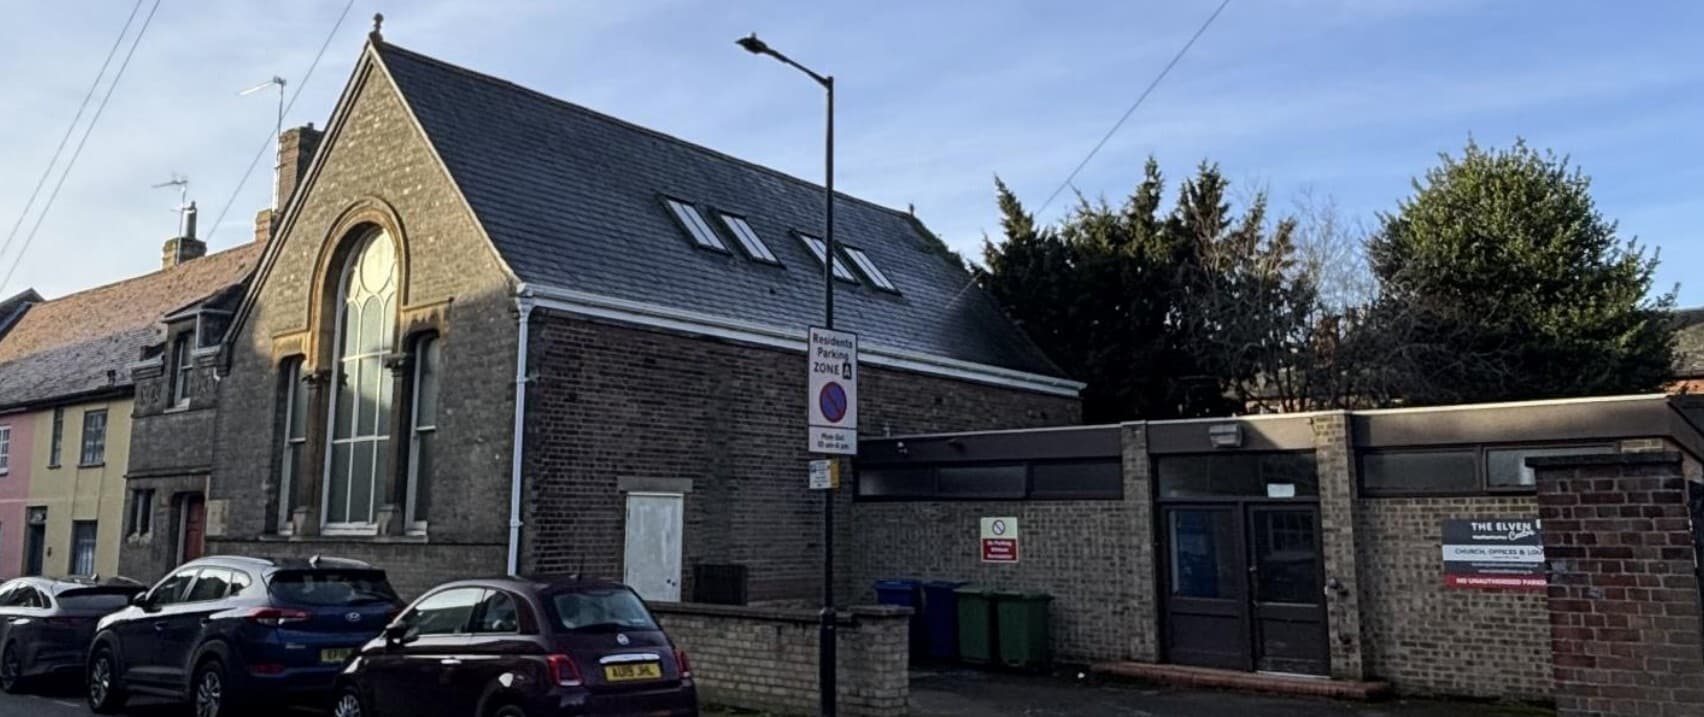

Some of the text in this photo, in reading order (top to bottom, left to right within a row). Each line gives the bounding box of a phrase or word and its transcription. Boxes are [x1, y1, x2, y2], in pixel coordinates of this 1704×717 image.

[812, 332, 853, 349] Residents
[816, 346, 849, 362] Parking
[813, 361, 852, 380] ZONE A
[1471, 522, 1531, 531] THE ELVEN
